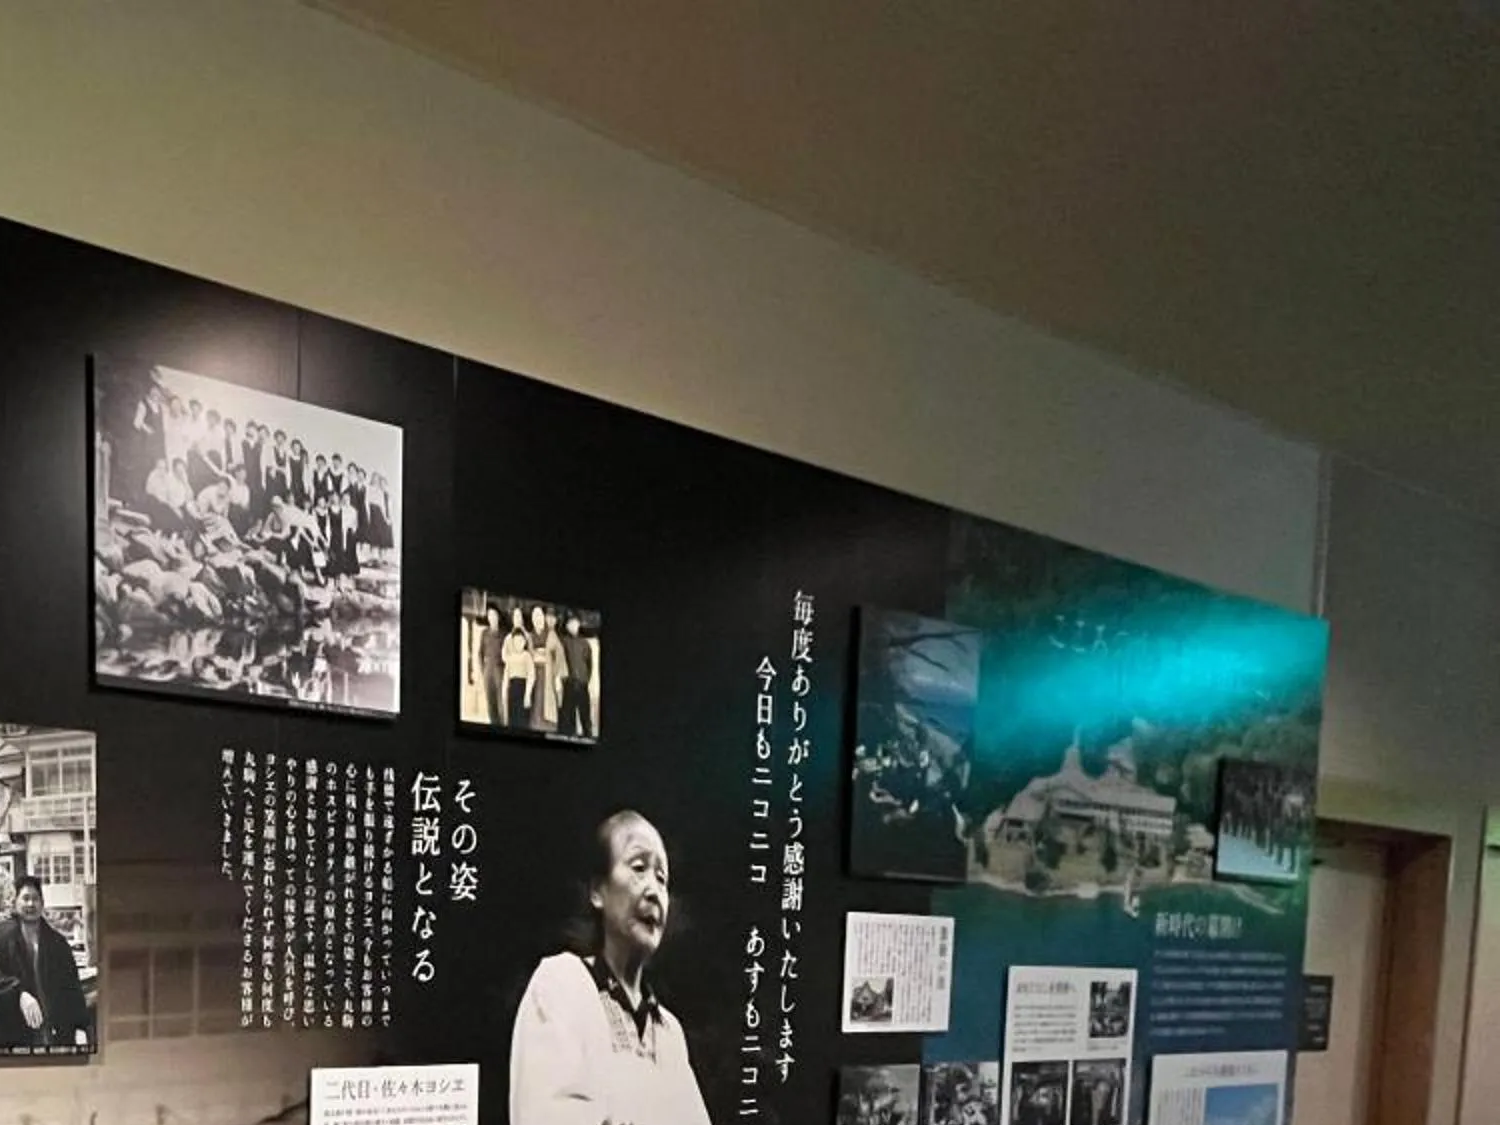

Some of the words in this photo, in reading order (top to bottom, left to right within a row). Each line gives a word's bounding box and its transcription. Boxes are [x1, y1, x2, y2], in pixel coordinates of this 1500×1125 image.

[450, 779, 479, 901] その姿
[750, 656, 777, 883] 今日もニコニコ
[775, 590, 815, 1083] 毎度ありがとう感謝いたします
[411, 771, 442, 983] 伝説となる
[325, 1078, 466, 1102] 二代目・佐々木ヨシエ
